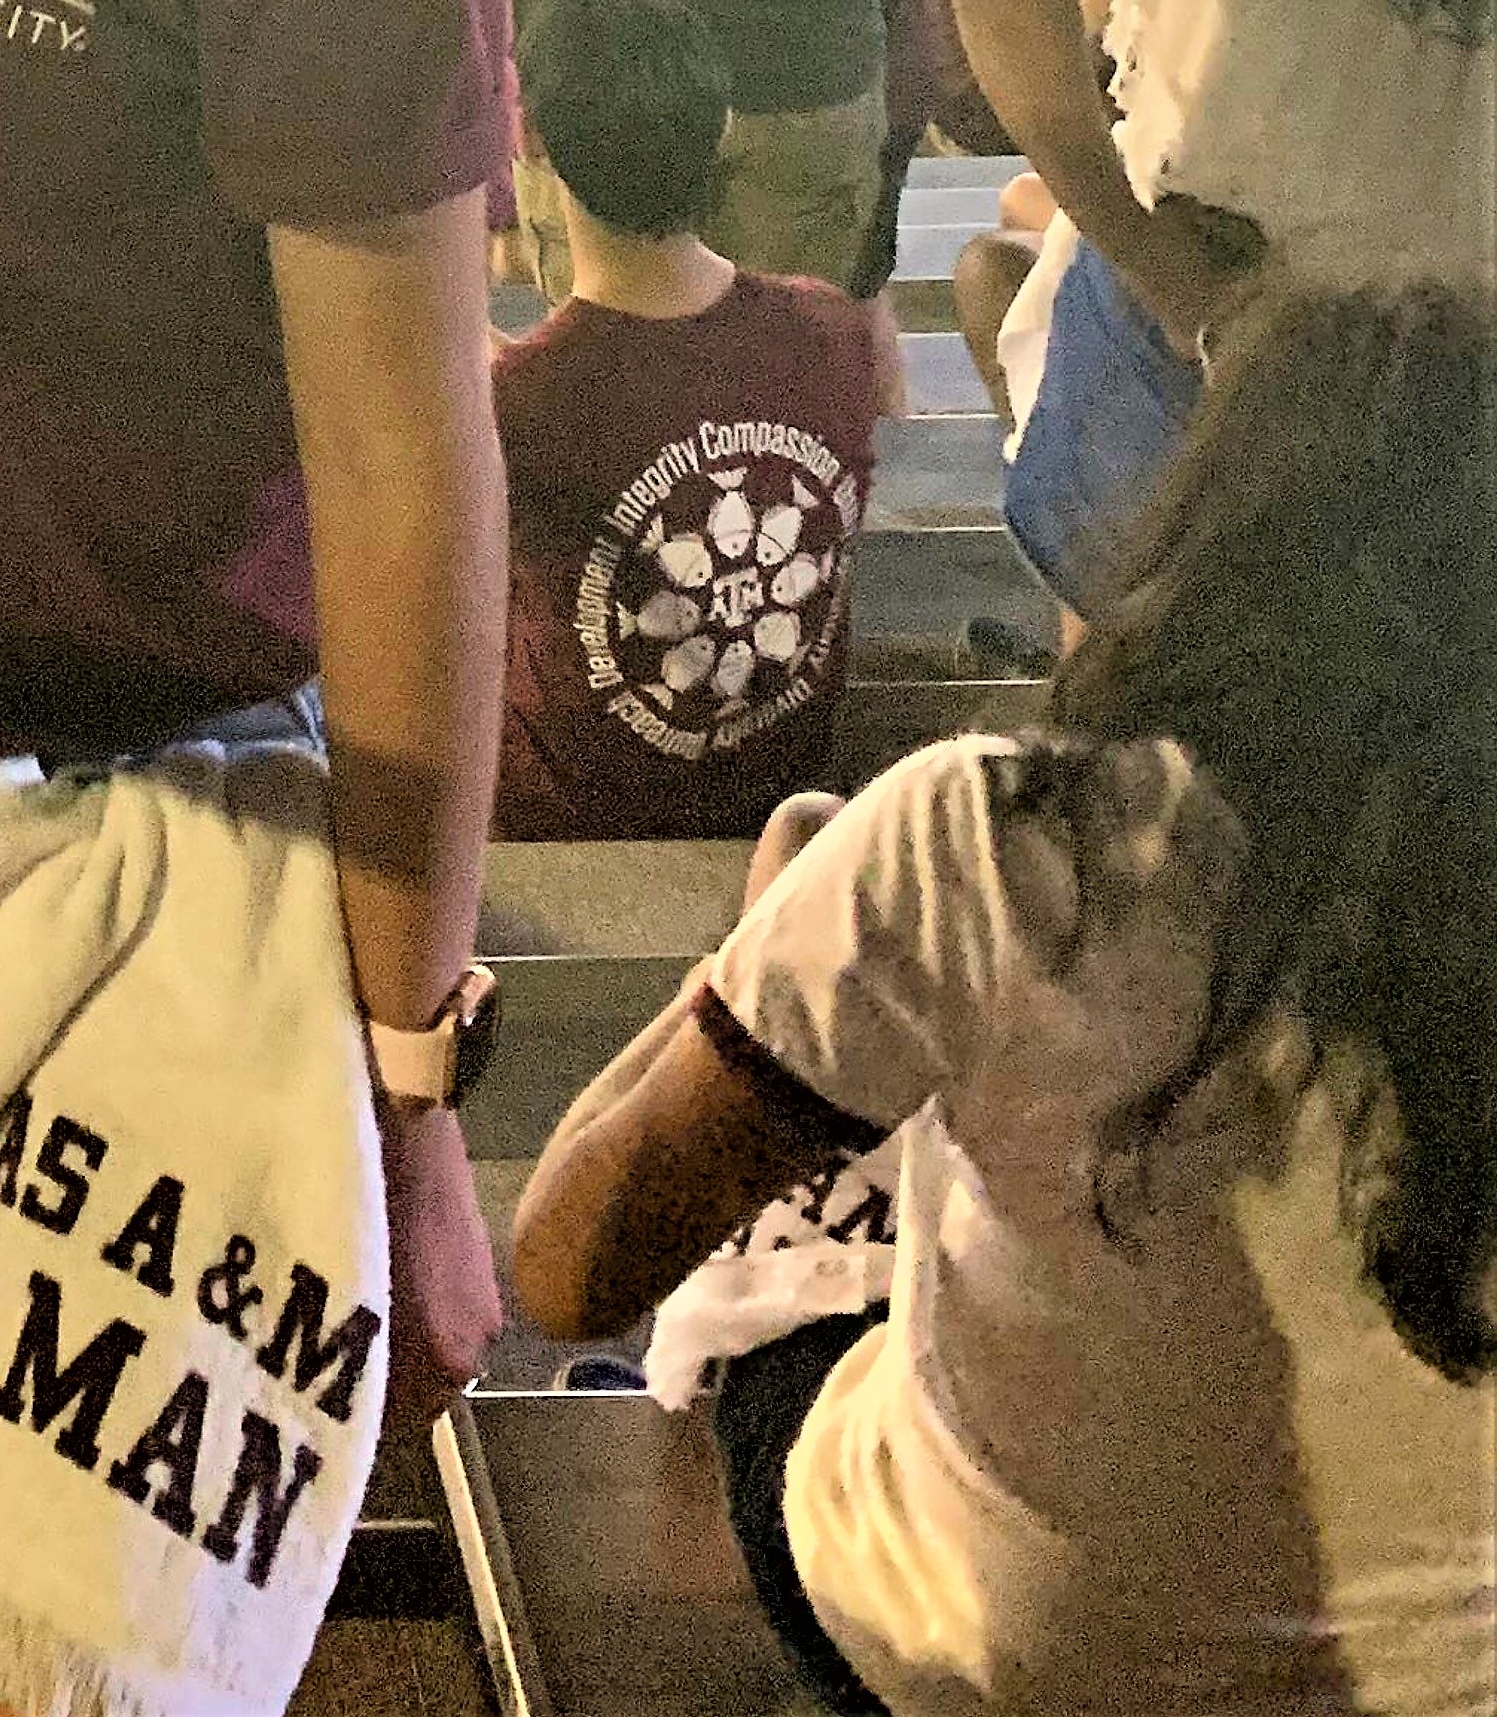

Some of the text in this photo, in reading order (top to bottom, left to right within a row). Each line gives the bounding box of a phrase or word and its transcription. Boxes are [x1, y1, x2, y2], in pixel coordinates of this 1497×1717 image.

[605, 420, 843, 537] Integrity Compassion
[100, 1175, 382, 1424] A&M
